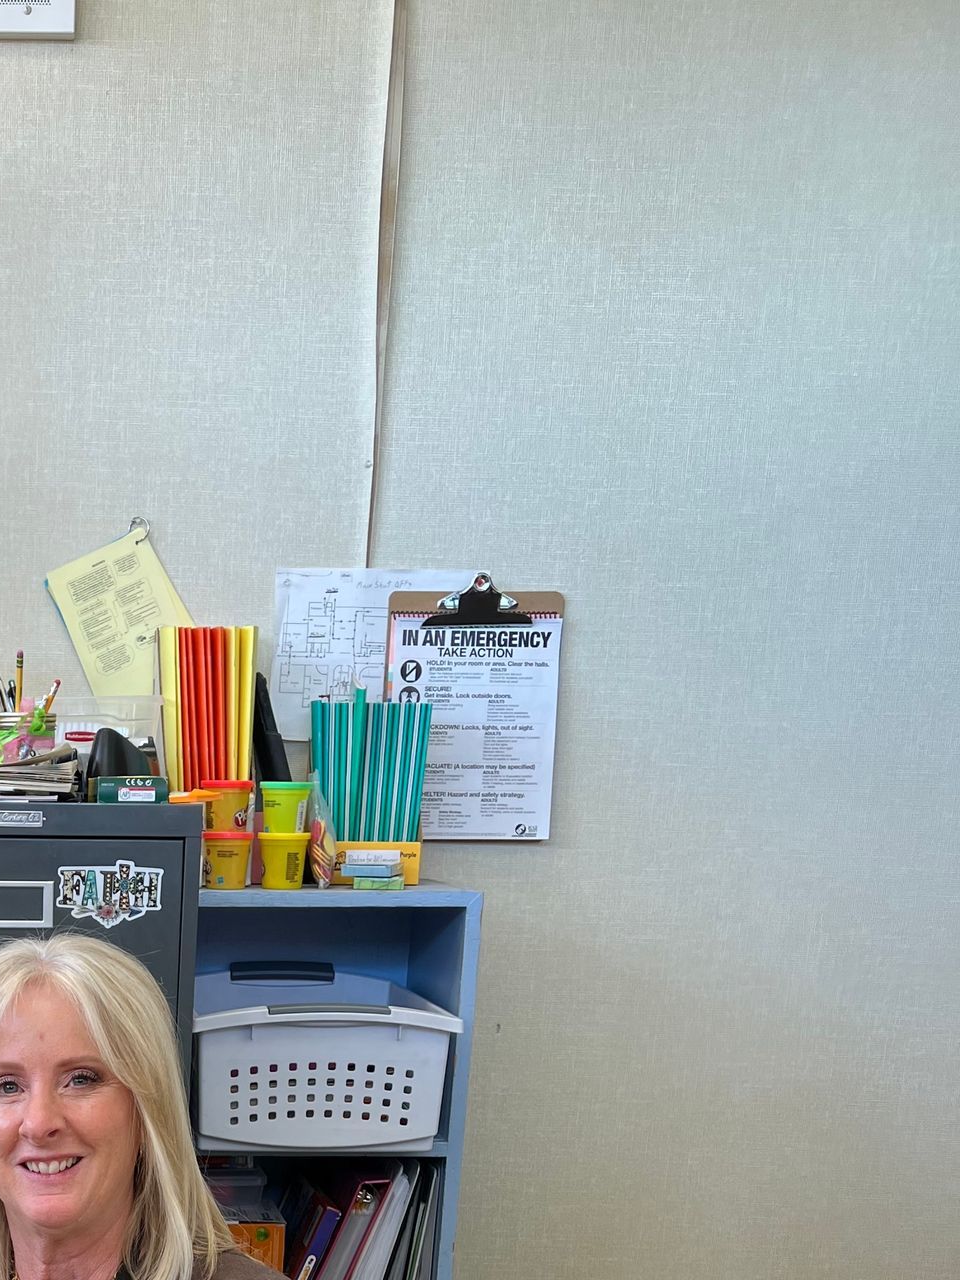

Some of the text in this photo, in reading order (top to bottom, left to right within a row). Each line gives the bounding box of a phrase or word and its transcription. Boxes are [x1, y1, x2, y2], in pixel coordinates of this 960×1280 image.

[402, 629, 553, 648] IN AN EMERGENCY
[437, 647, 514, 658] TAKE ACTION
[400, 851, 417, 859] Purple
[59, 864, 161, 914] FAITH
